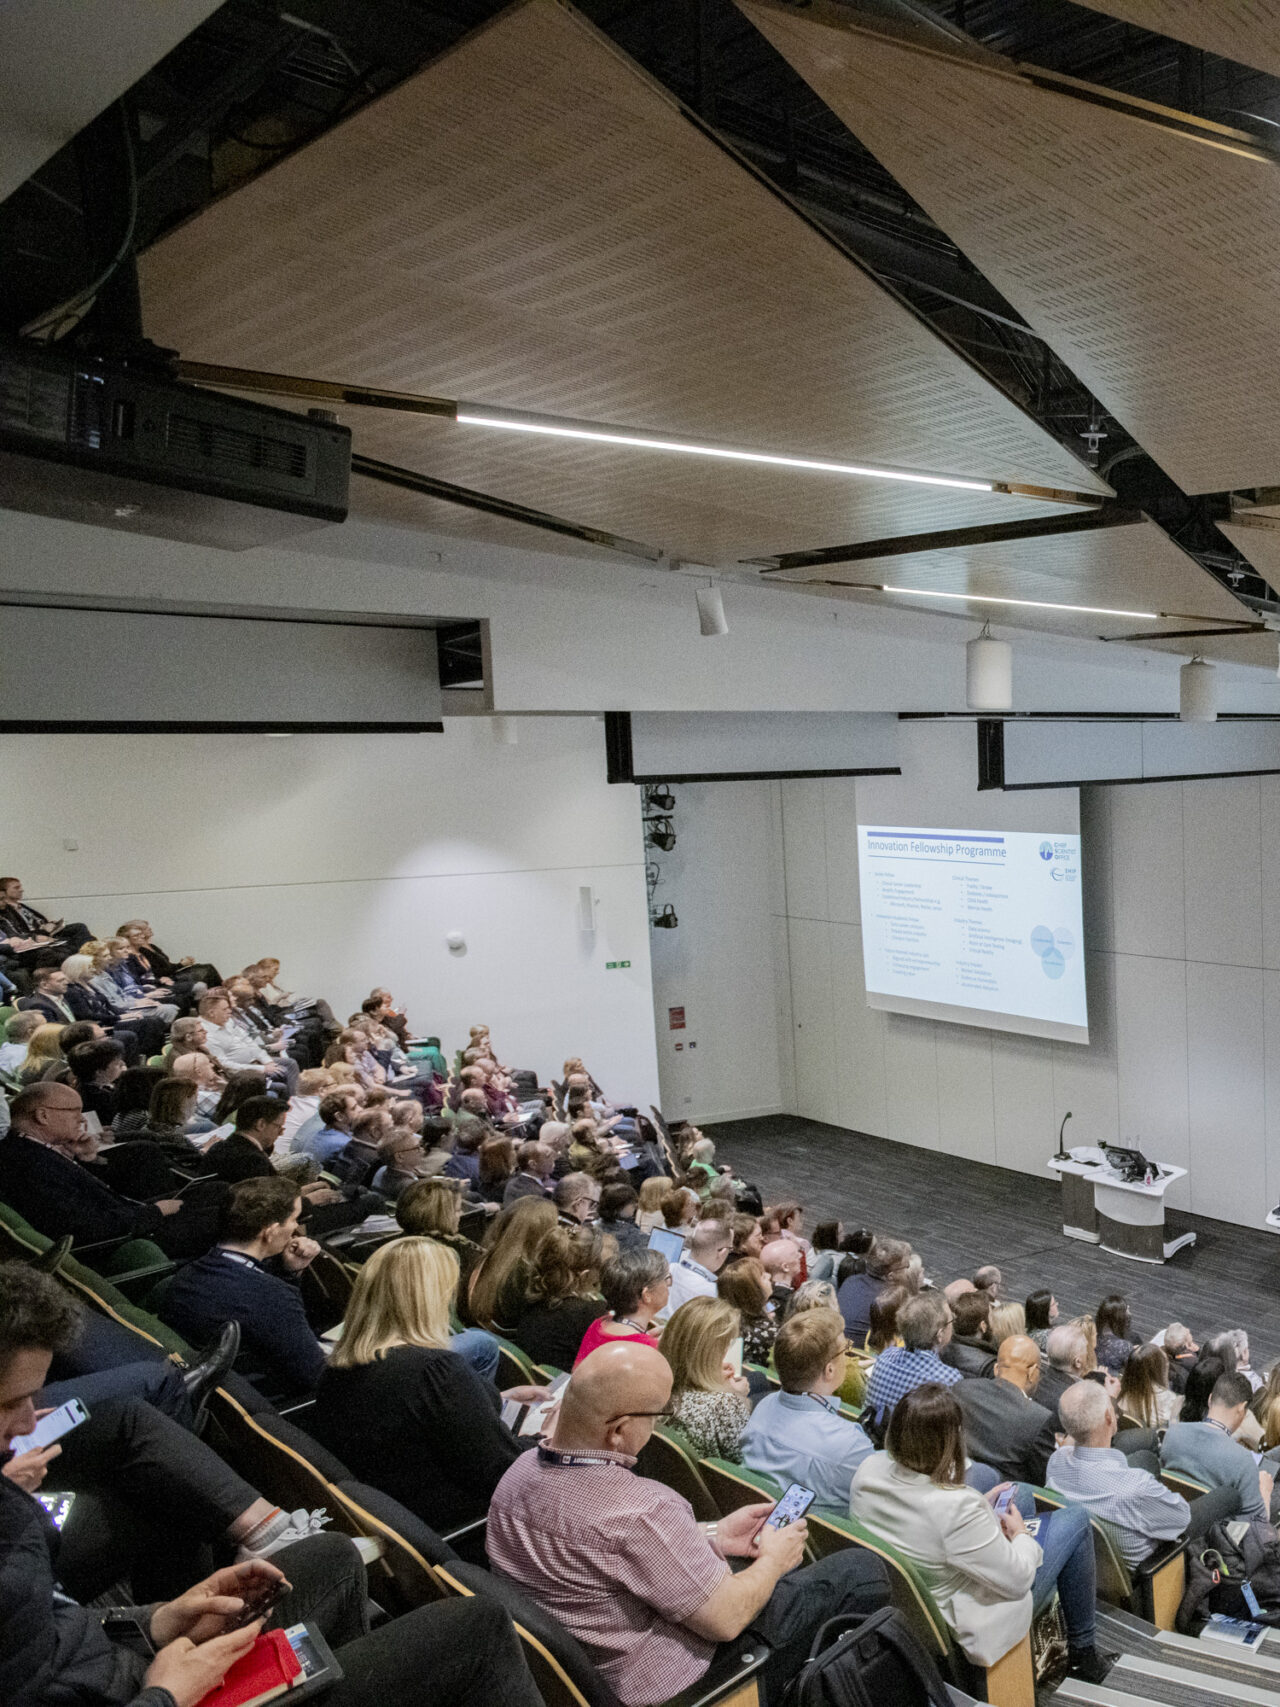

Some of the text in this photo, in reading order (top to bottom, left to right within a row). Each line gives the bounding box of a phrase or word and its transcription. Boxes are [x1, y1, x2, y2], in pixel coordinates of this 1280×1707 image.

[868, 840, 1007, 858] Innovation Fellowship Programme
